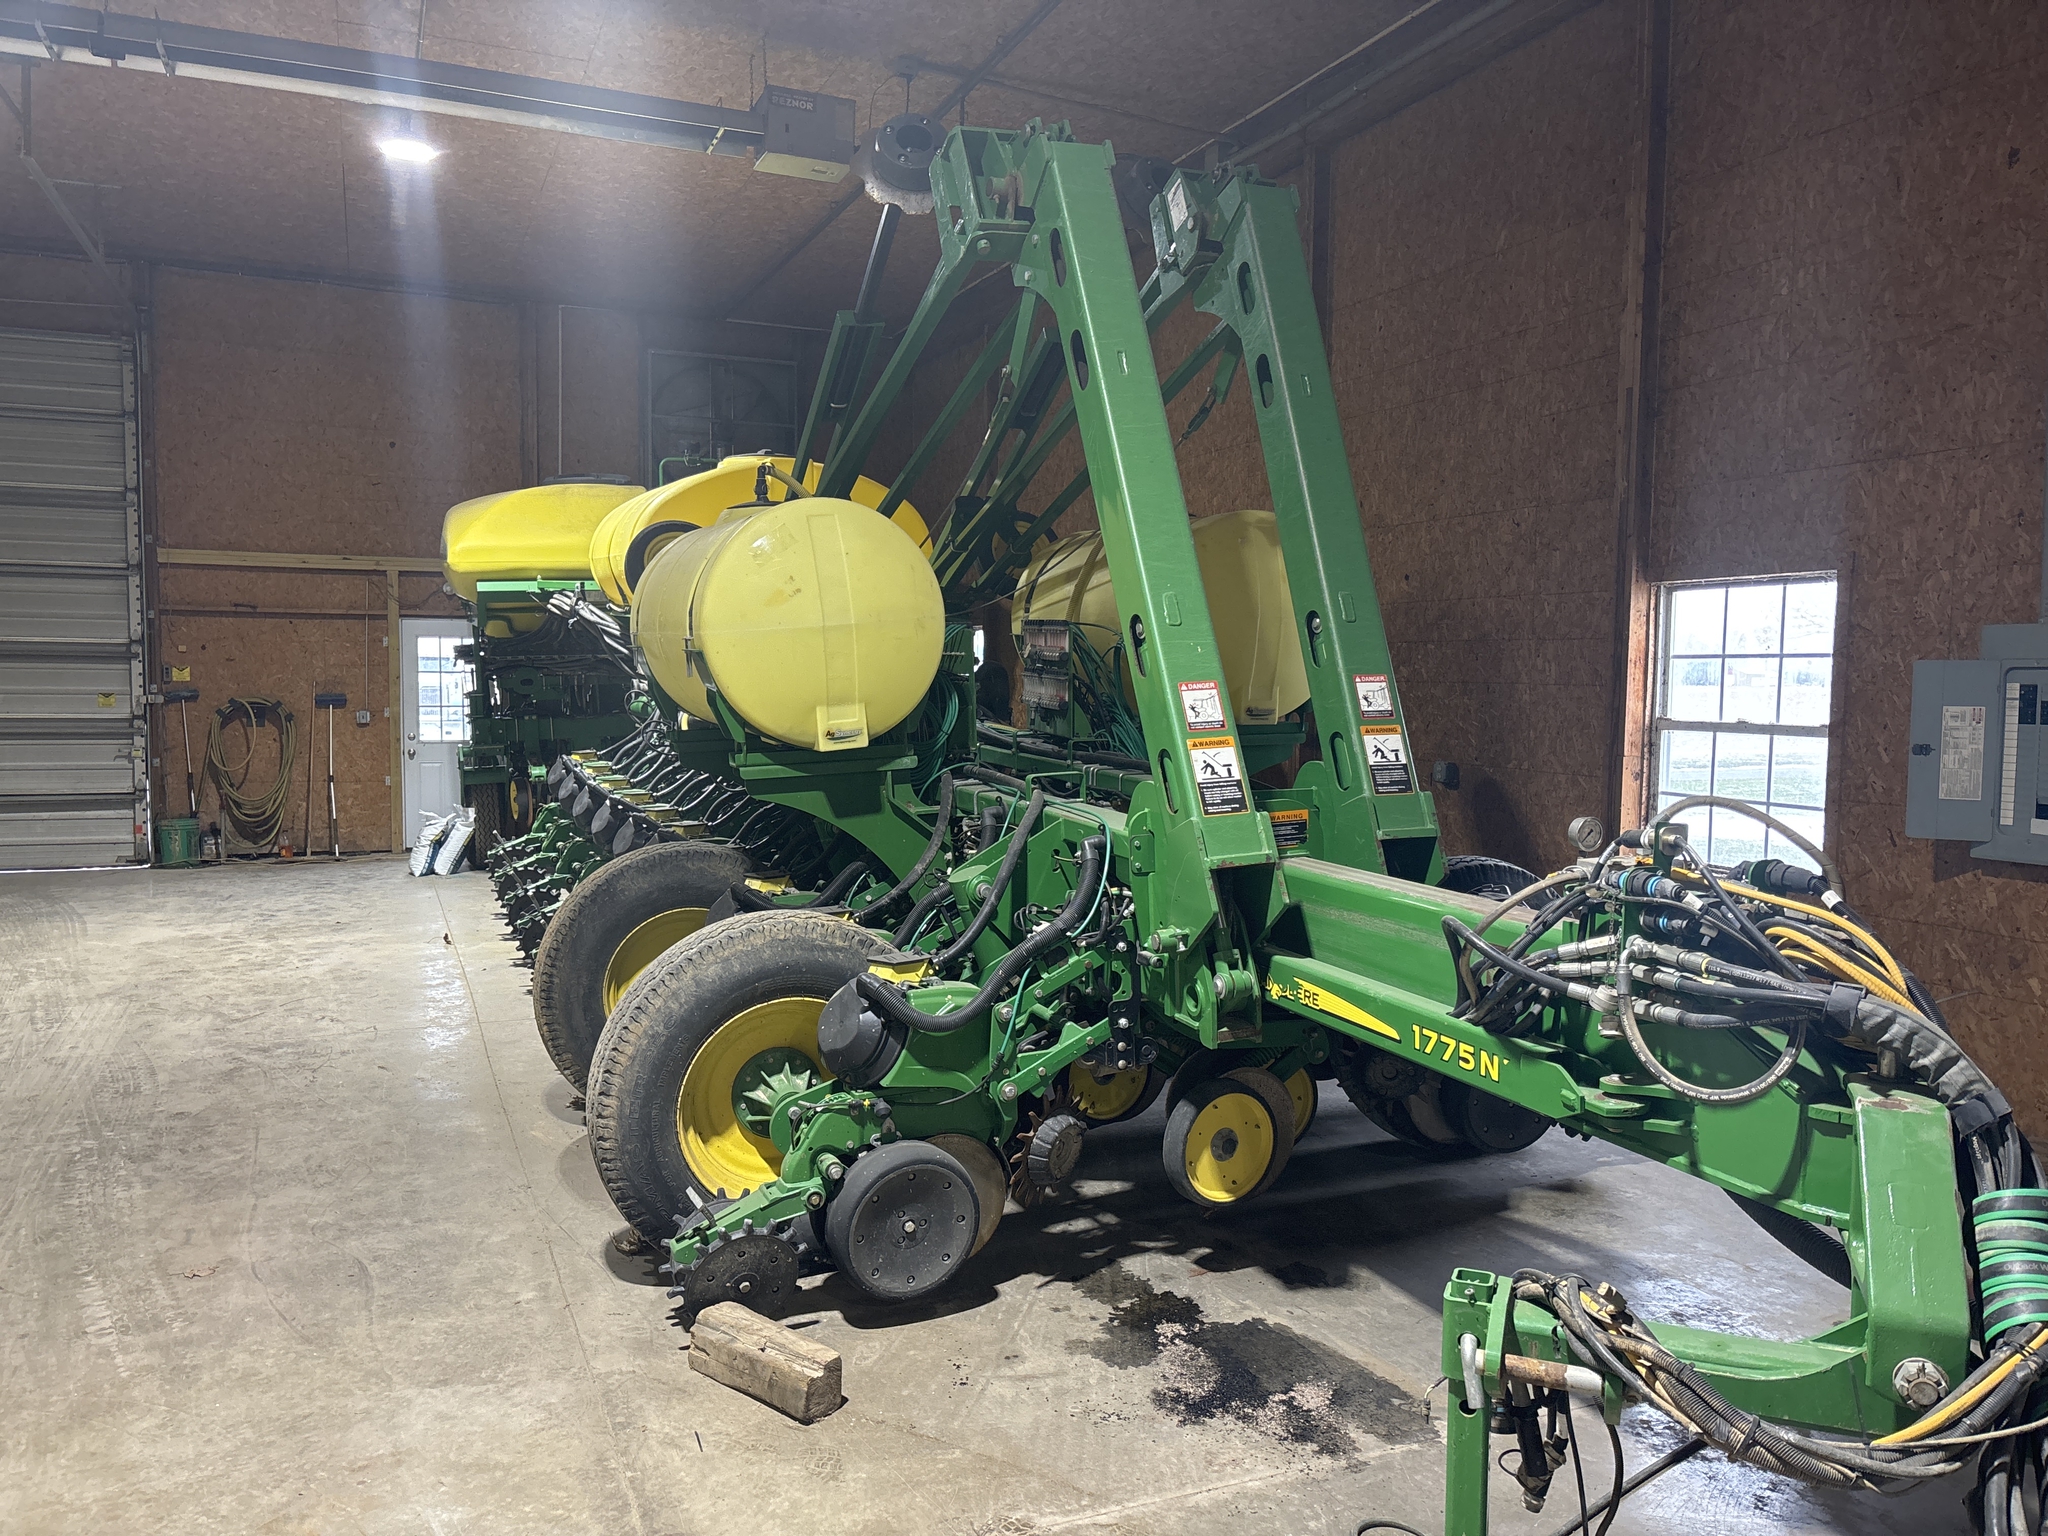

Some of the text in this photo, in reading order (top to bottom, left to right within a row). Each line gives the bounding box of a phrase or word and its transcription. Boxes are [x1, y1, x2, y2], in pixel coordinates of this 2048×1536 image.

[772, 95, 814, 110] REZNOR
[1187, 682, 1216, 690] DANGER
[1197, 739, 1231, 747] WARNING
[1411, 1023, 1510, 1083] 1775N
